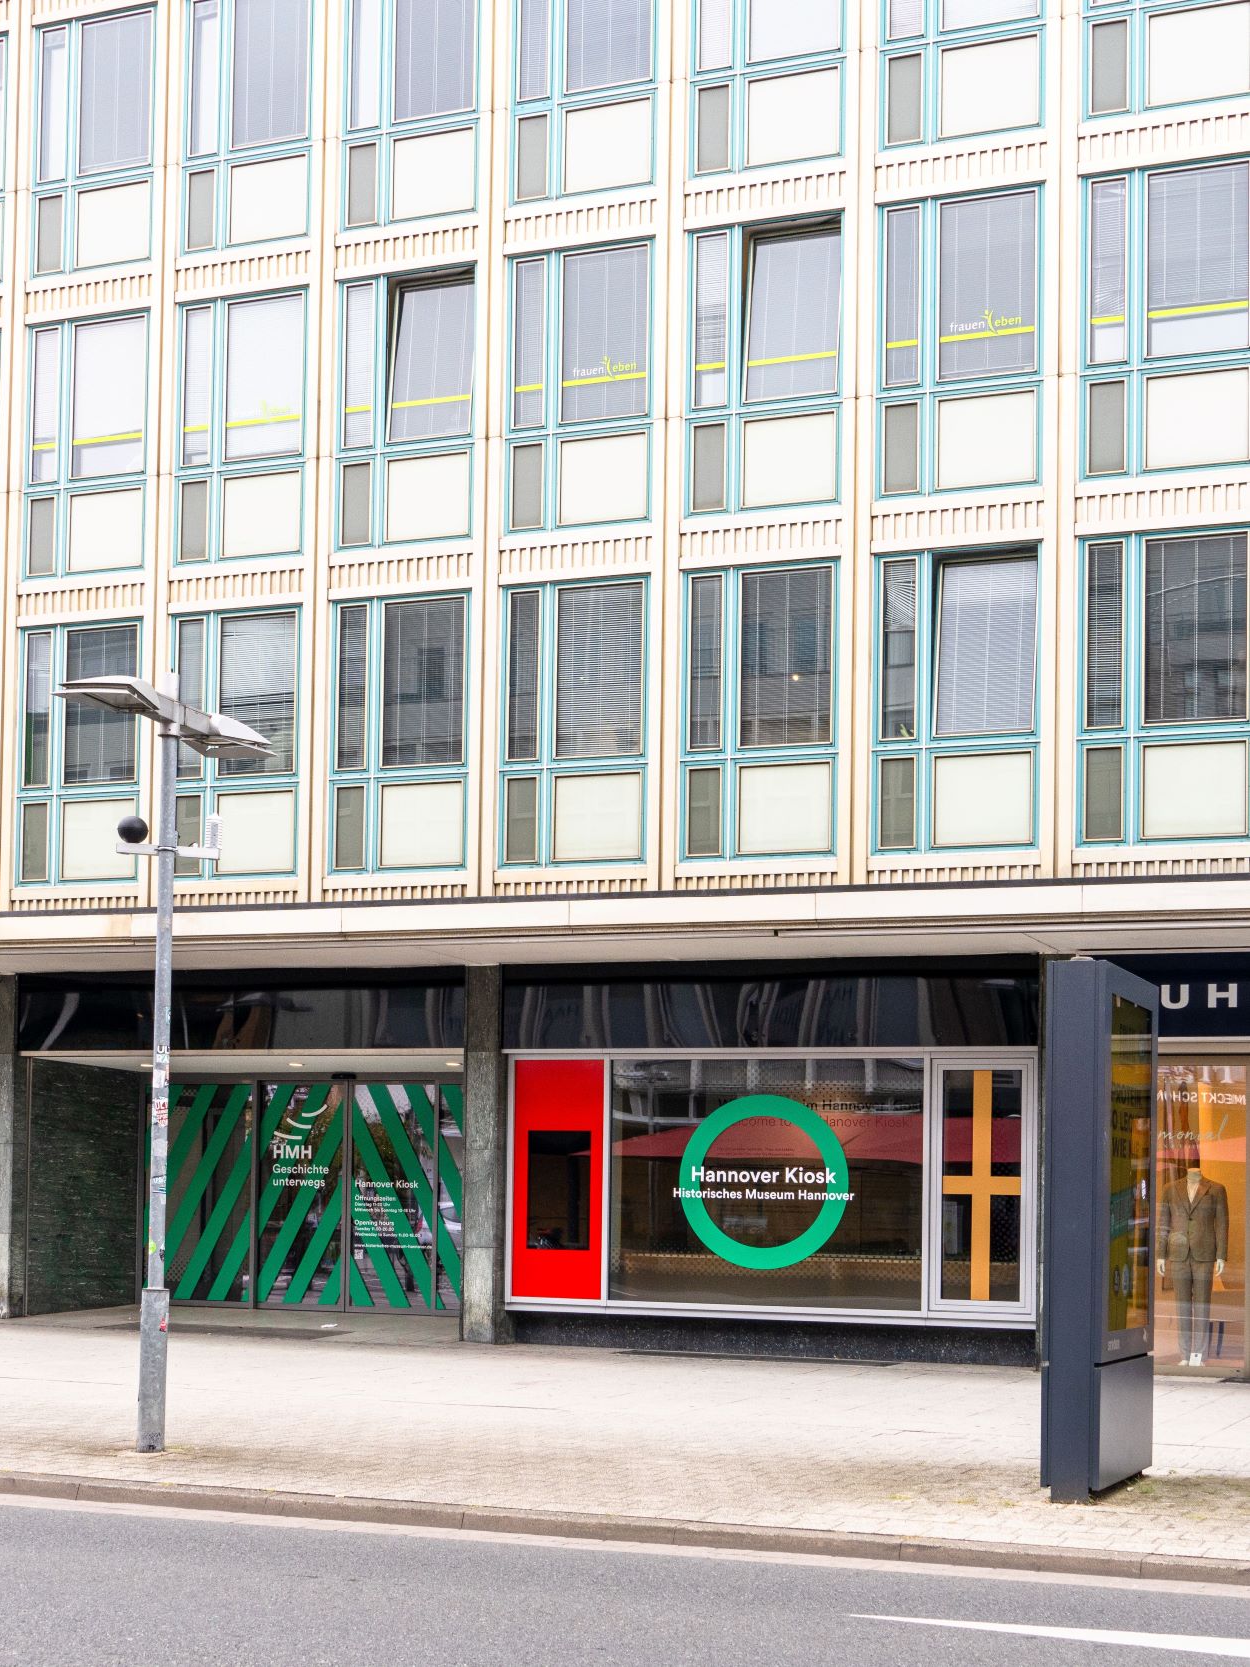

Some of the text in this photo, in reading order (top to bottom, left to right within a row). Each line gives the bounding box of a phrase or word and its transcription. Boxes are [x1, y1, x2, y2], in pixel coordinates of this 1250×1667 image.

[157, 1045, 170, 1054] UL
[875, 1114, 909, 1127] Kiosk
[273, 1145, 312, 1159] HMH
[272, 1163, 329, 1174] Geschichte
[691, 1166, 836, 1184] Hannover Kiosk
[272, 1177, 326, 1189] unterwegs
[355, 1179, 418, 1188] Hannover Kiosk
[673, 1188, 854, 1201] Historisches Museum Hannover
